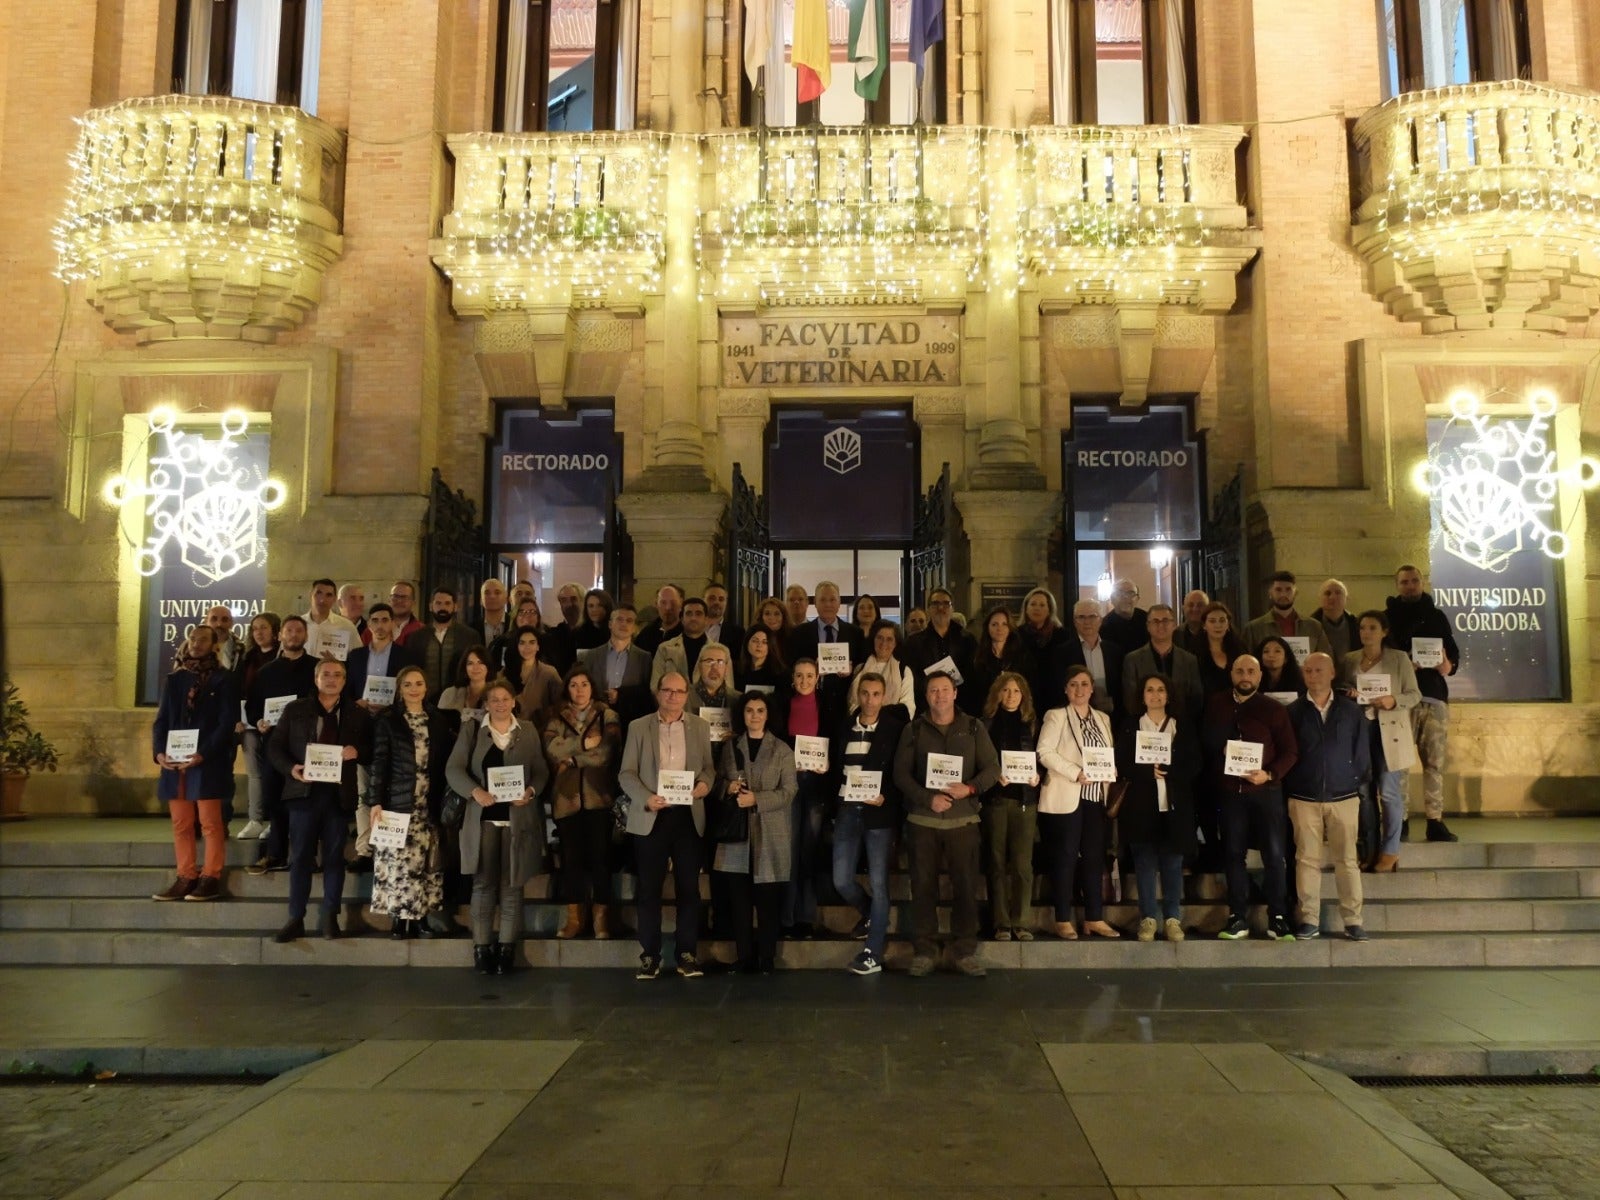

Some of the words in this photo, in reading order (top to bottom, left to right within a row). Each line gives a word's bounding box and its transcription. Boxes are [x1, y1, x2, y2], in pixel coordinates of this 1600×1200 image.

[759, 322, 920, 346] FACVLTAD
[726, 344, 755, 357] 1941
[828, 347, 852, 359] DE
[925, 342, 956, 355] 1999
[737, 360, 945, 384] VETERINARIA
[502, 454, 609, 471] RECTORADO
[1077, 450, 1188, 467] RECTORADO
[1455, 607, 1542, 632] CÓRDOBA
